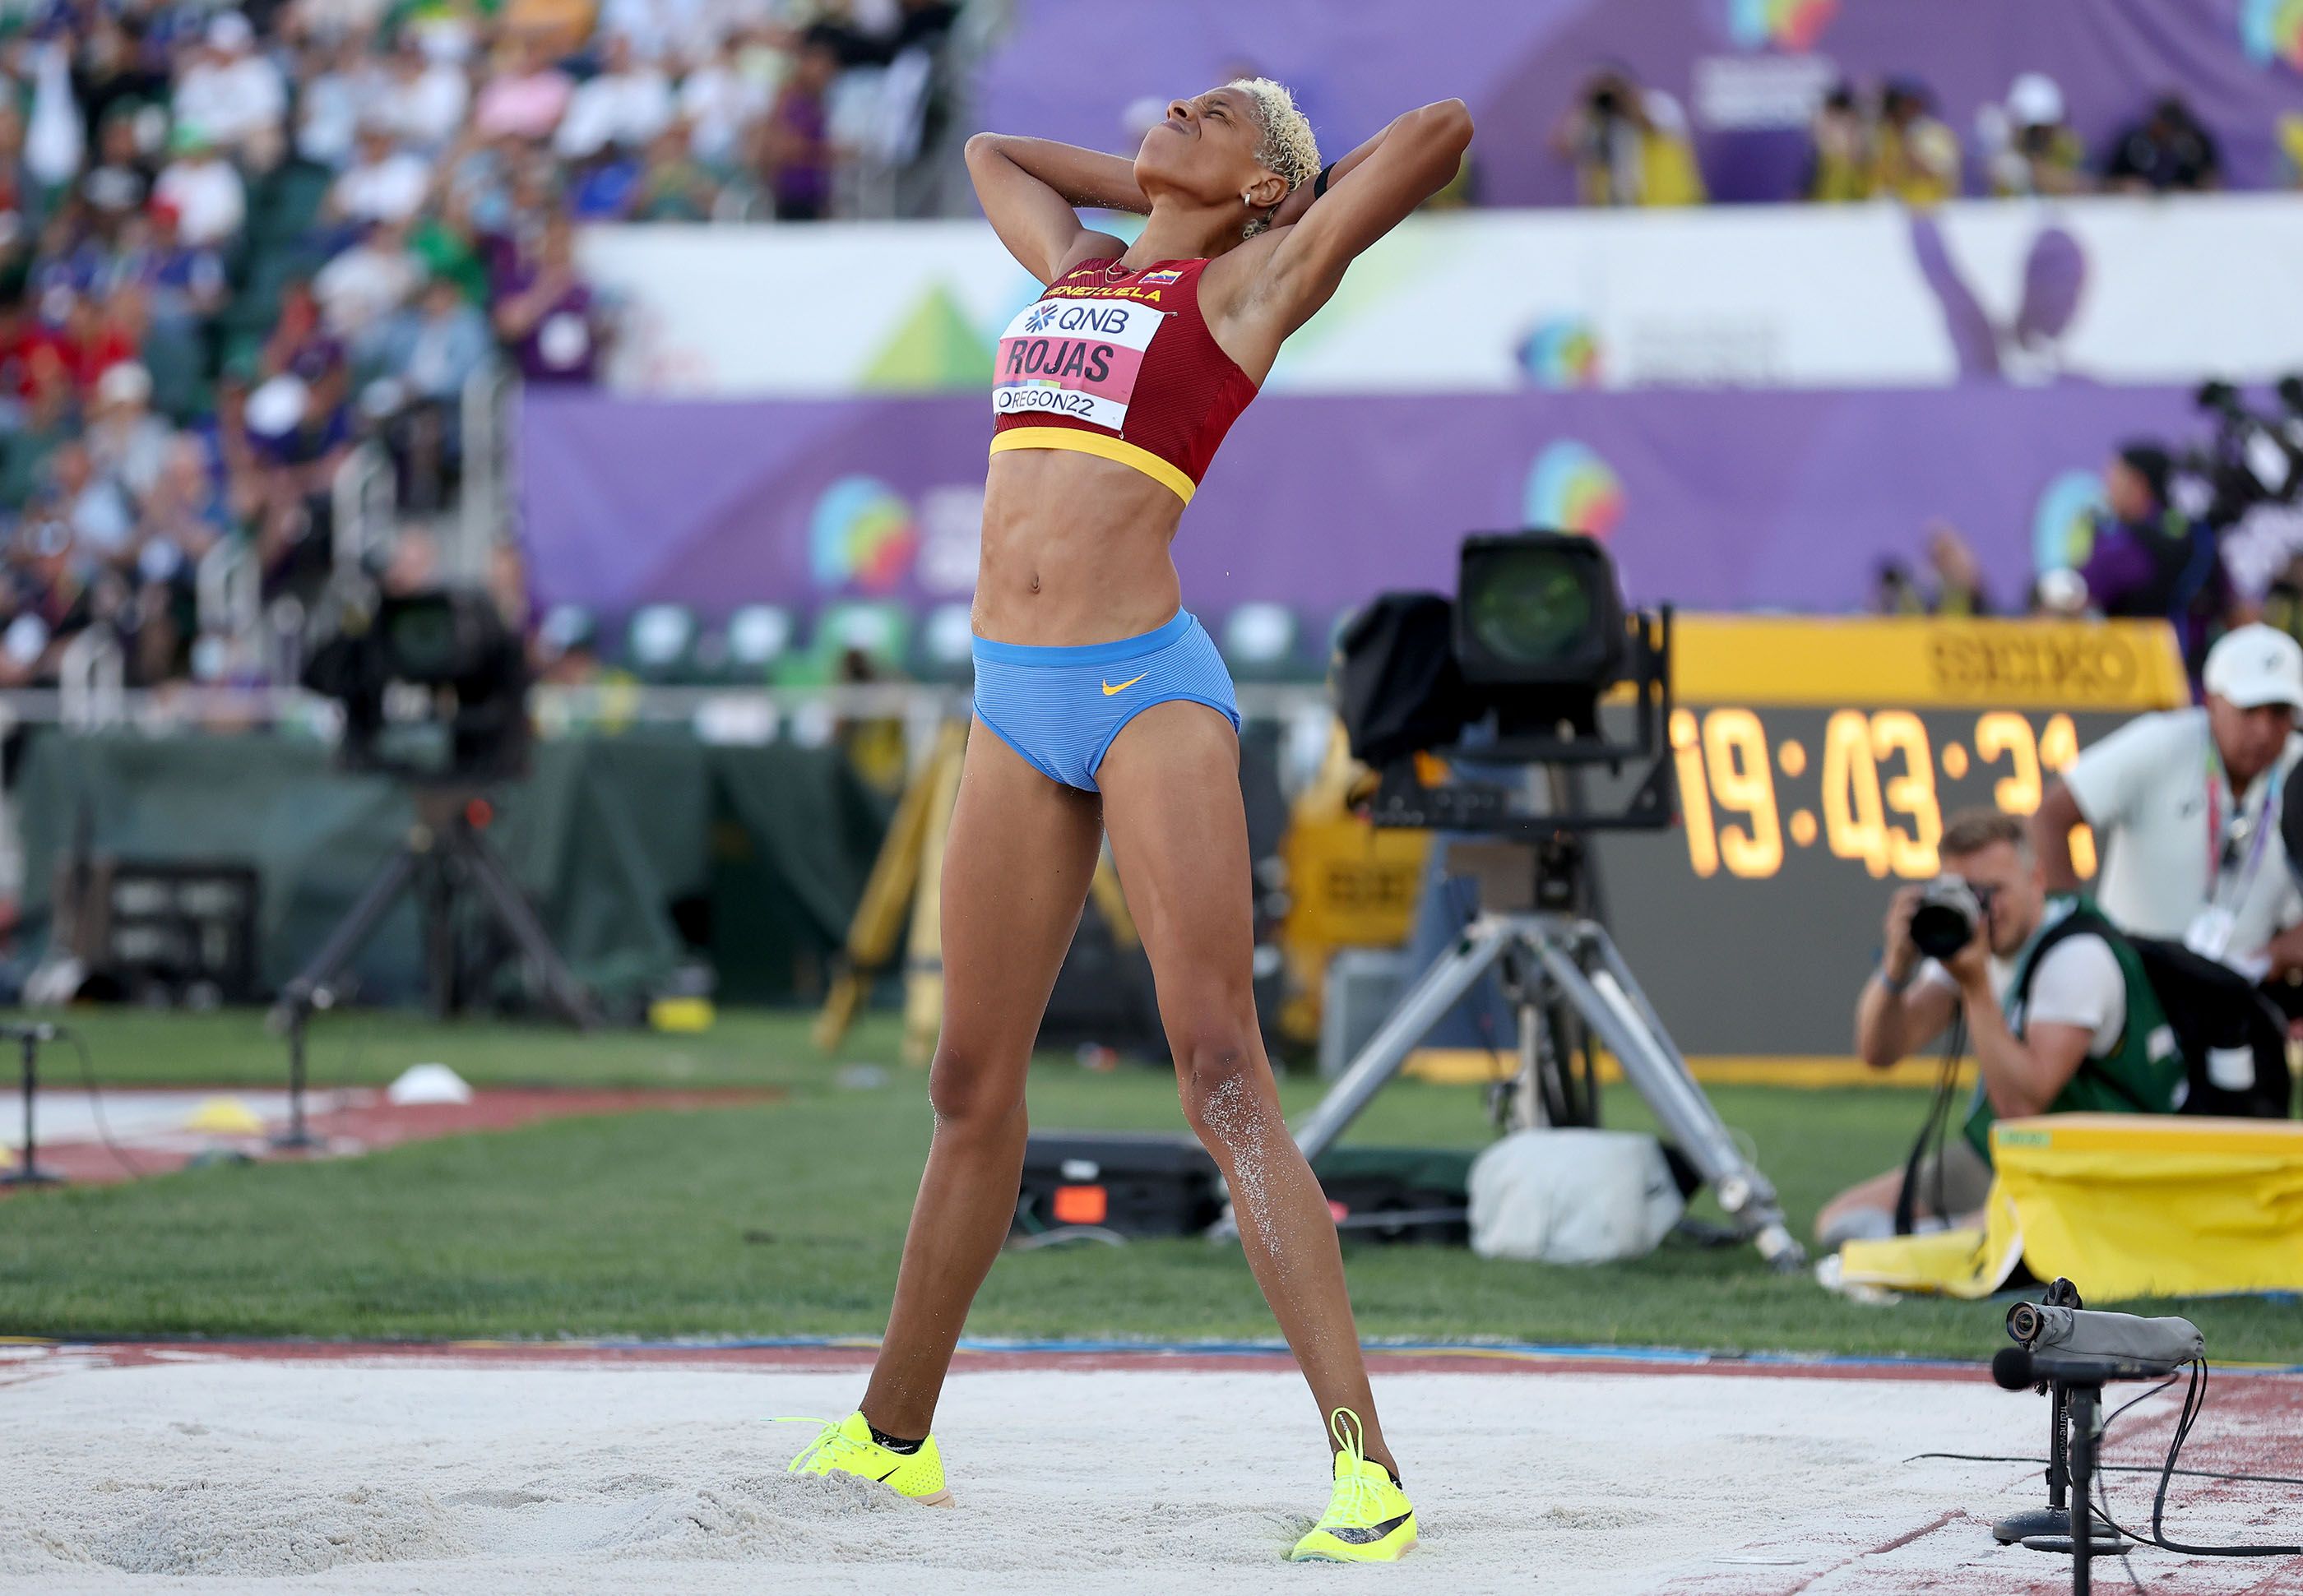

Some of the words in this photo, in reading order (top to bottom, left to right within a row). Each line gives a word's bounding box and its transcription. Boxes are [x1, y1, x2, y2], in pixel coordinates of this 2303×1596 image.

[1059, 307, 1129, 334] QNB
[1005, 339, 1114, 382] ROJAS
[999, 390, 1095, 417] OREGON22
